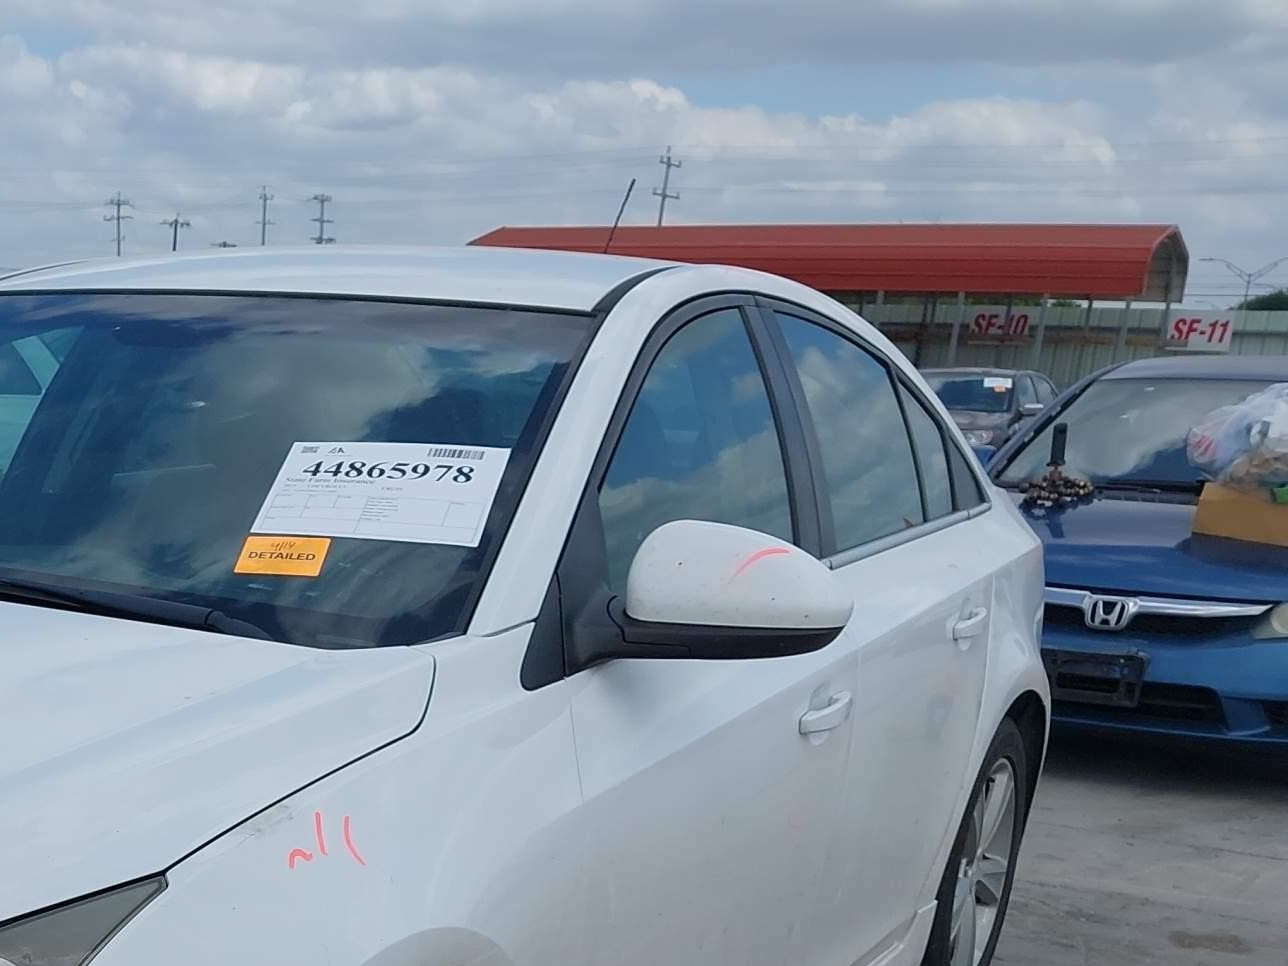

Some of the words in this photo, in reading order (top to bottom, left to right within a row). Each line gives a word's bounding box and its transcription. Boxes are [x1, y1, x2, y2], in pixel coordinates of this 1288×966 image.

[972, 313, 1029, 336] SF-10
[1170, 317, 1231, 343] SF-11
[302, 460, 475, 483] 44865978
[248, 551, 316, 561] DETAILED
